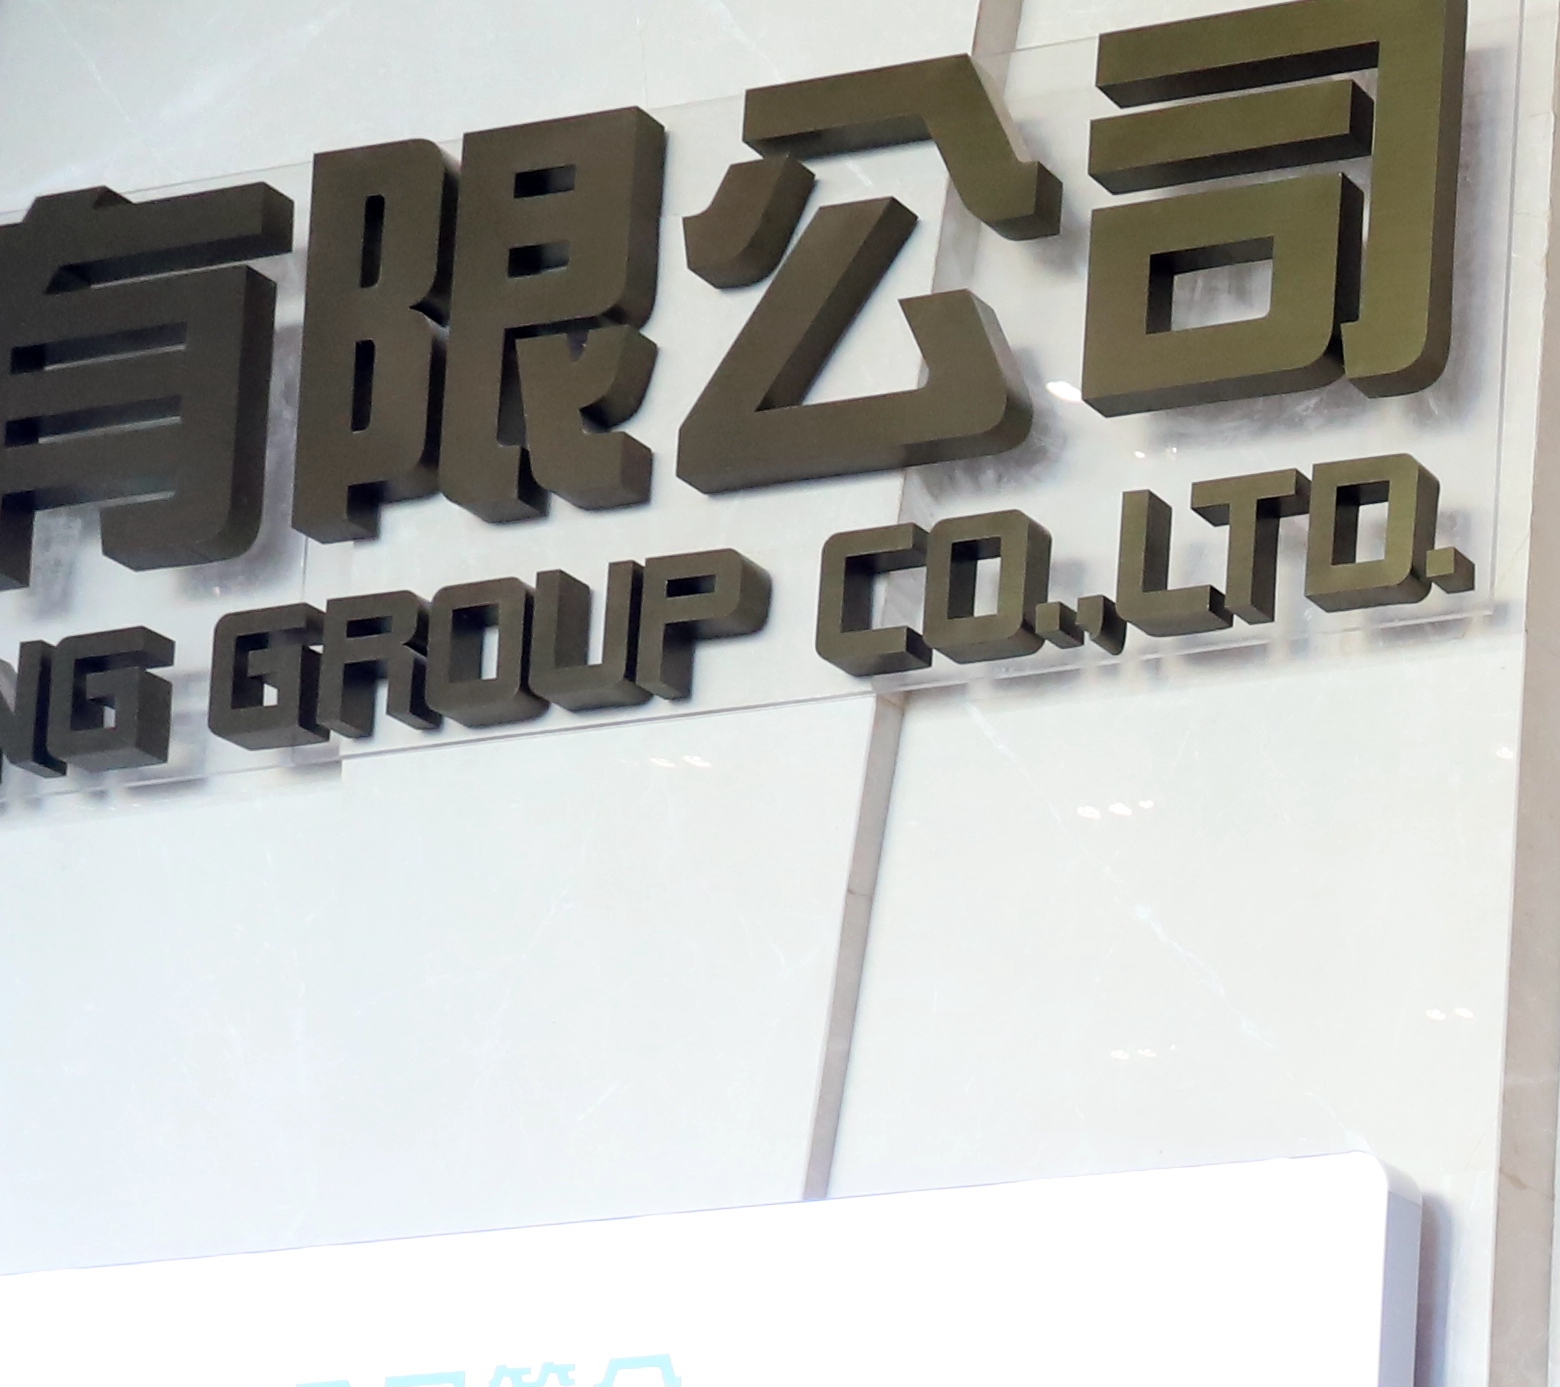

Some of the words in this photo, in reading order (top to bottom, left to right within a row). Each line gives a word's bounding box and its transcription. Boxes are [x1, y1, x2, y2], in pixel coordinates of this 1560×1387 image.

[0, 0, 1468, 592] 有限公司
[206, 546, 773, 752] GROUP
